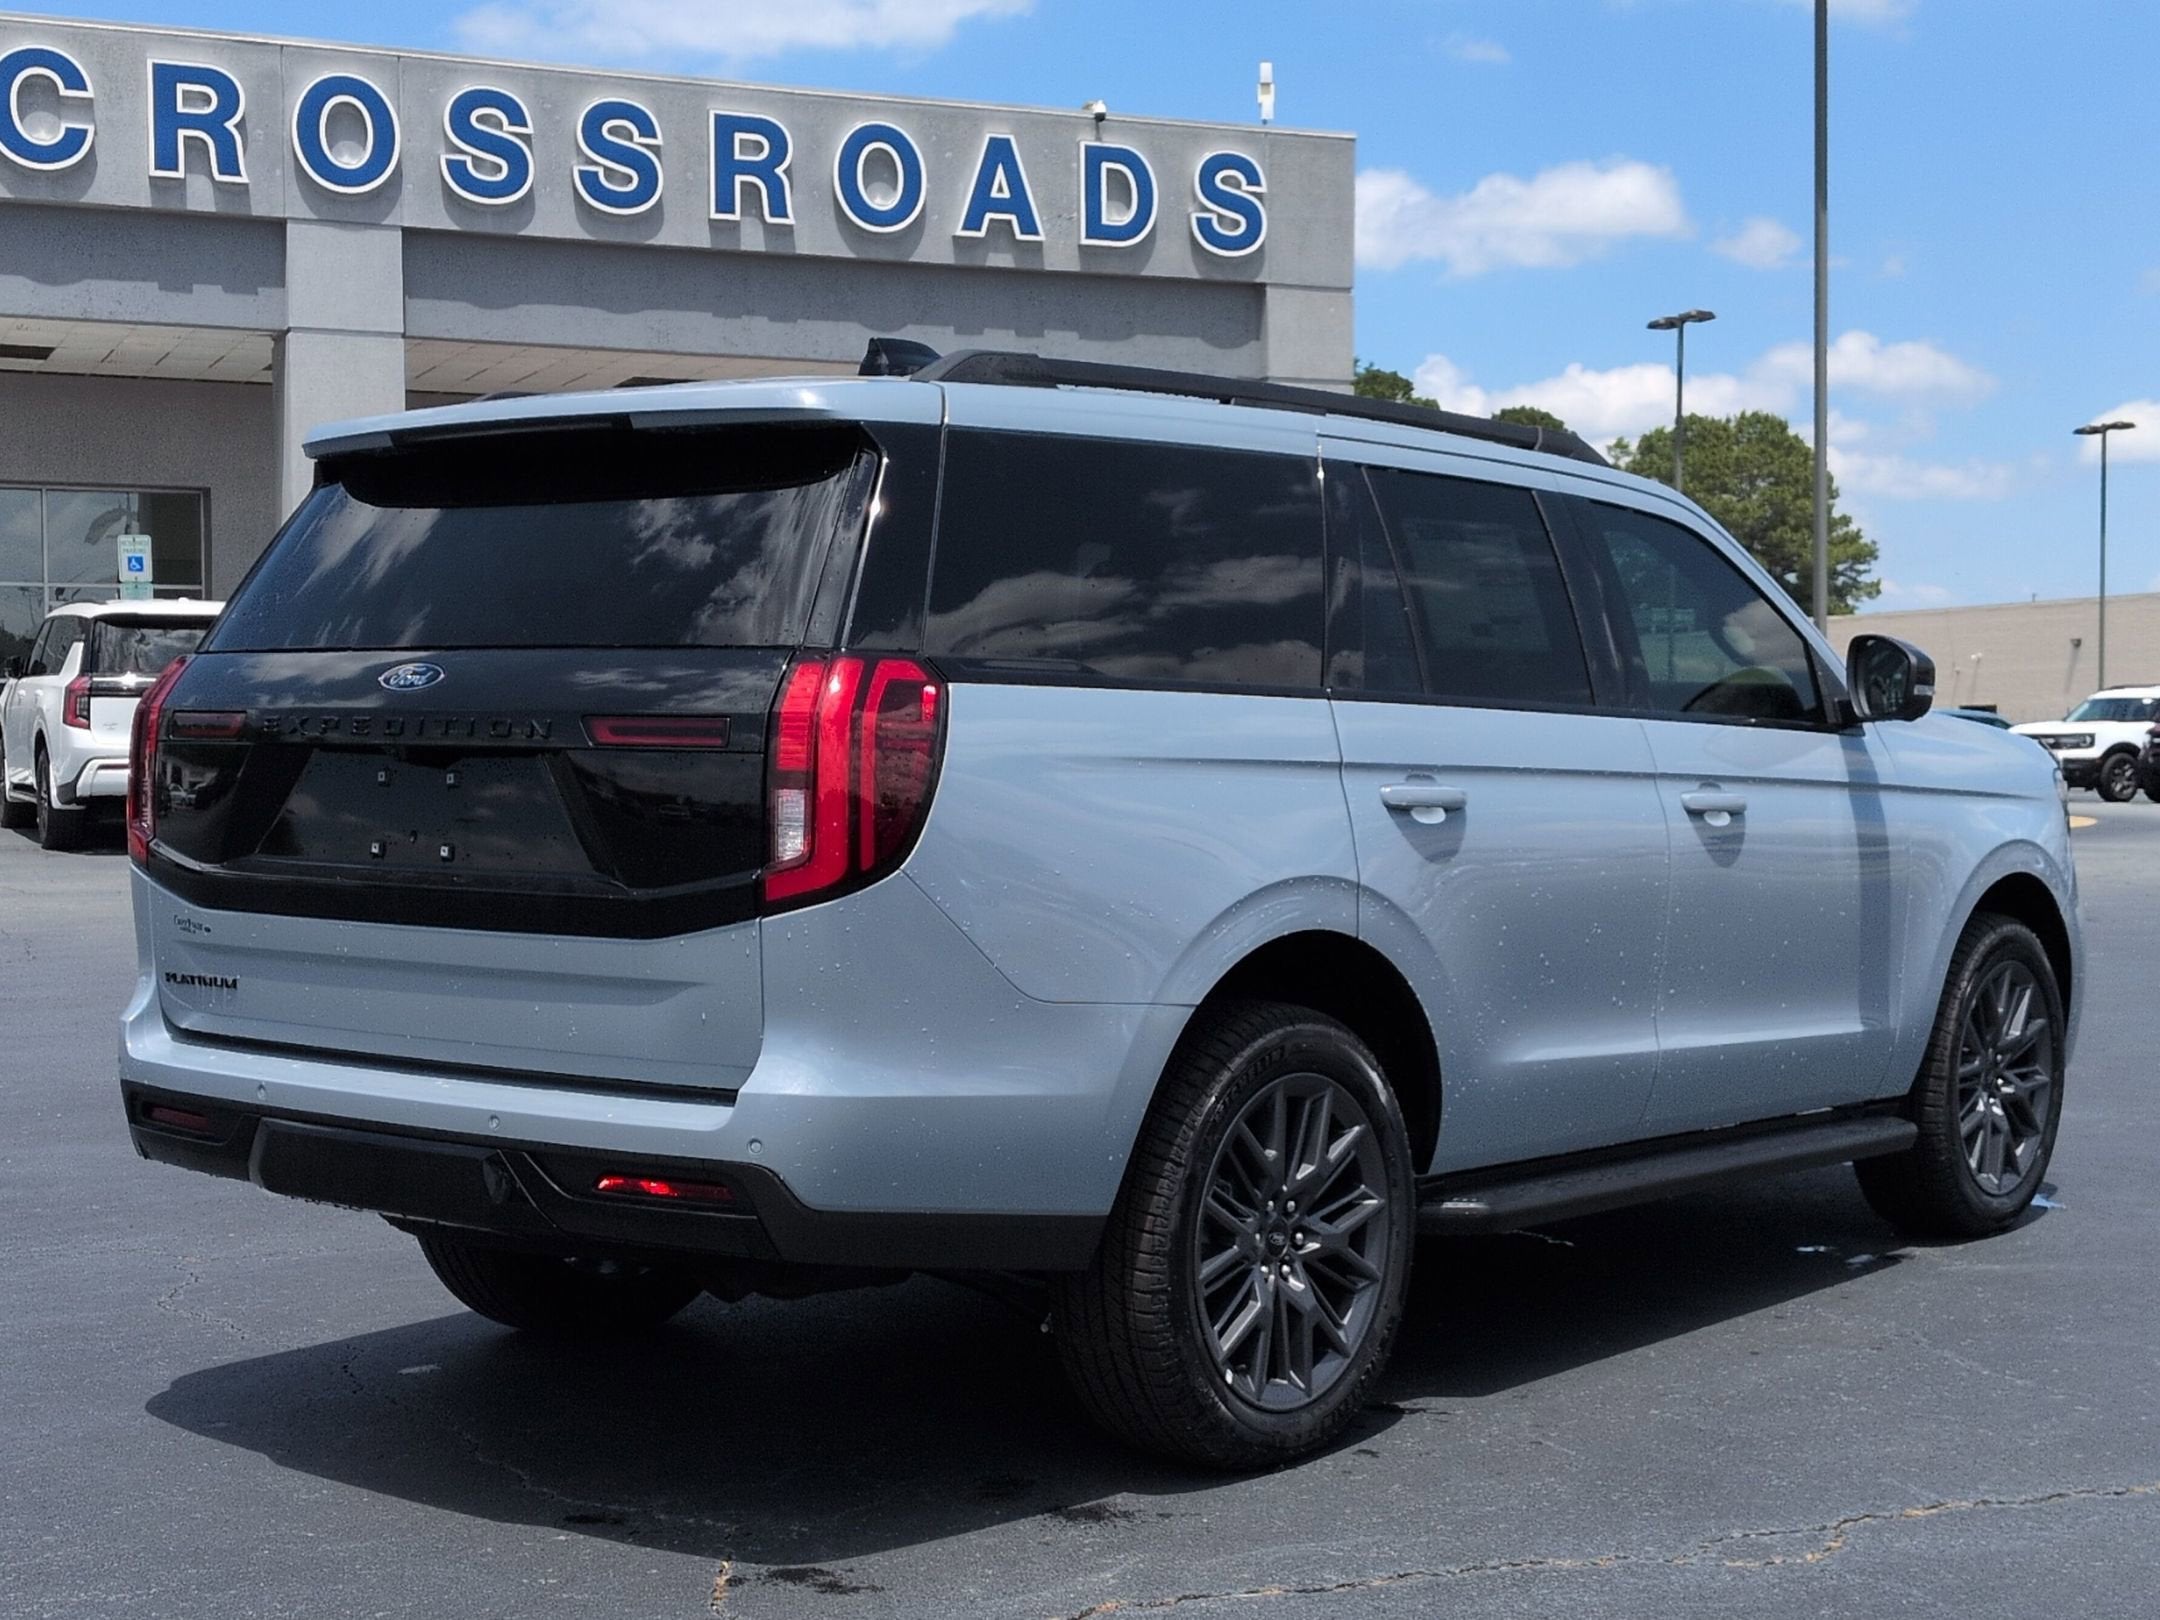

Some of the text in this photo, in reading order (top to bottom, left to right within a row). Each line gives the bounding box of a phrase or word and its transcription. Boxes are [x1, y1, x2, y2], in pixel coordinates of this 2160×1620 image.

[0, 45, 1268, 257] CROSSROADS
[388, 665, 435, 687] Ford
[262, 714, 552, 740] EXPEDITION
[165, 971, 238, 990] PLATINUM
